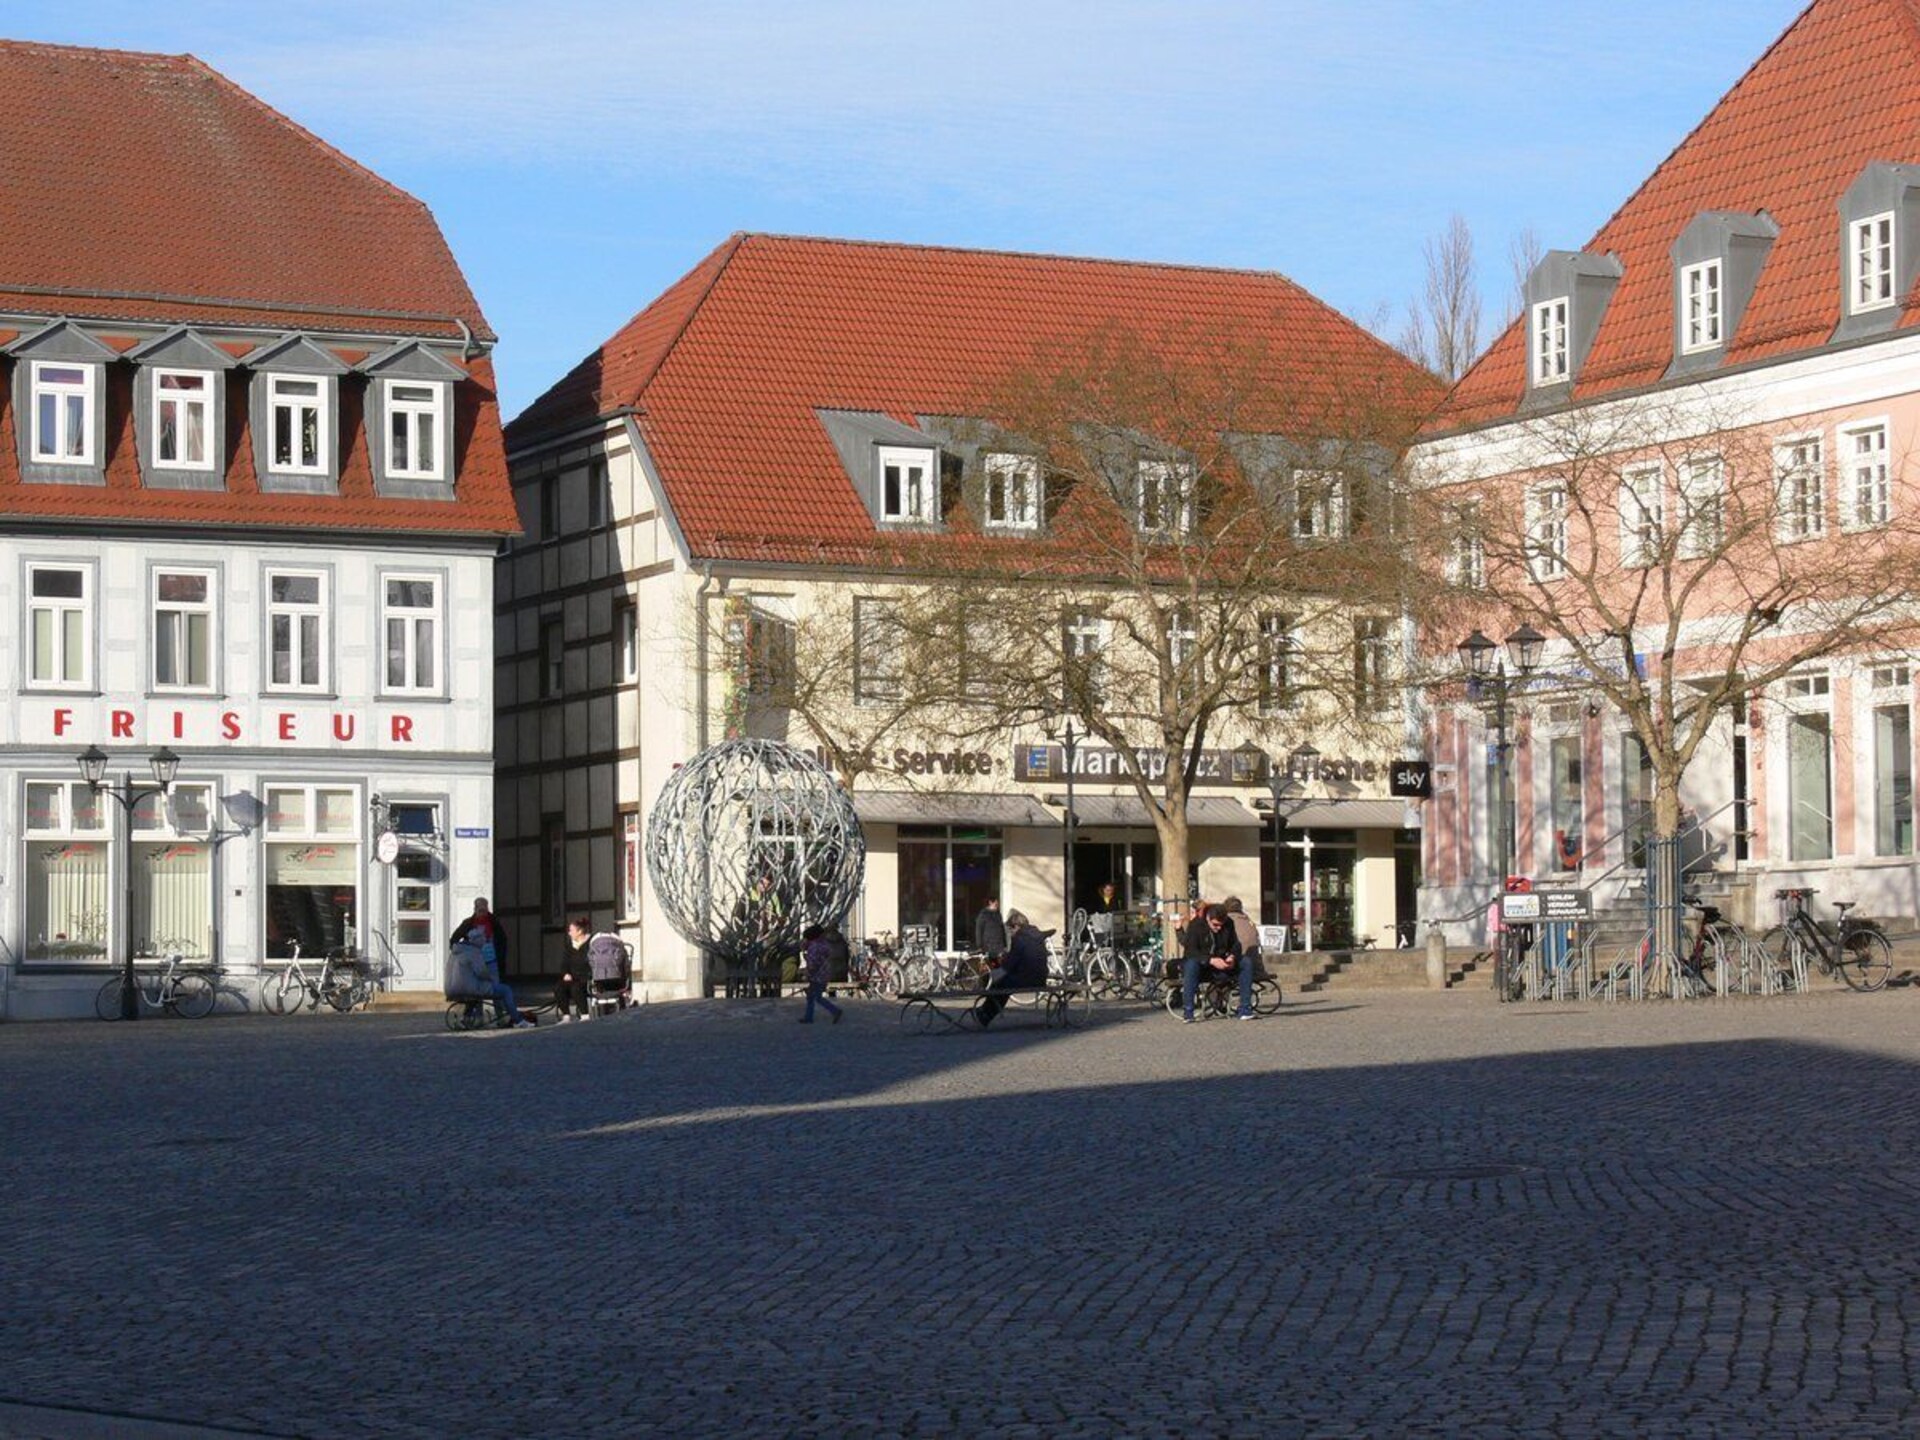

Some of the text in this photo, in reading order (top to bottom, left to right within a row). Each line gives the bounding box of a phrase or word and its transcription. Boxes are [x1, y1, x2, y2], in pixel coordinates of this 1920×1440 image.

[53, 708, 413, 742] FRISEUR
[894, 748, 993, 775] Service
[1397, 770, 1425, 789] sky
